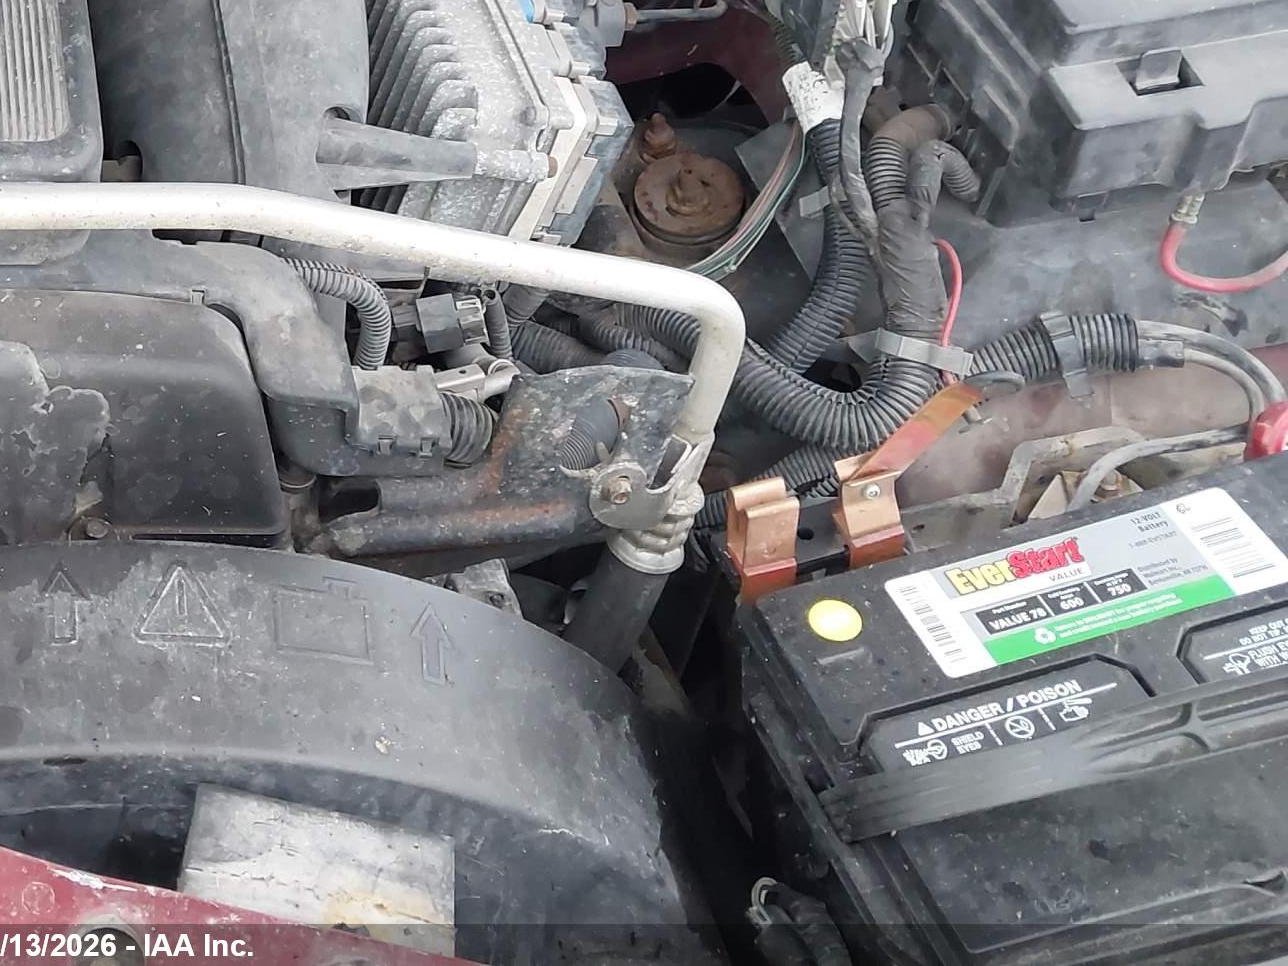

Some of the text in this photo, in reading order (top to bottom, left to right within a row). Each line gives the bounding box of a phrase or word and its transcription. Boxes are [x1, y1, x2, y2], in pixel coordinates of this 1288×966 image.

[1137, 521, 1169, 532] Battery
[944, 537, 1085, 596] EverStart
[1049, 568, 1083, 581] VALUE
[1107, 583, 1132, 595] 750
[1059, 597, 1084, 610] 600
[989, 607, 1047, 631] VALUE 78
[931, 702, 1004, 732] DANGER
[1016, 679, 1082, 708] POISON
[950, 731, 985, 747] SHIELD
[956, 741, 982, 755] EYES
